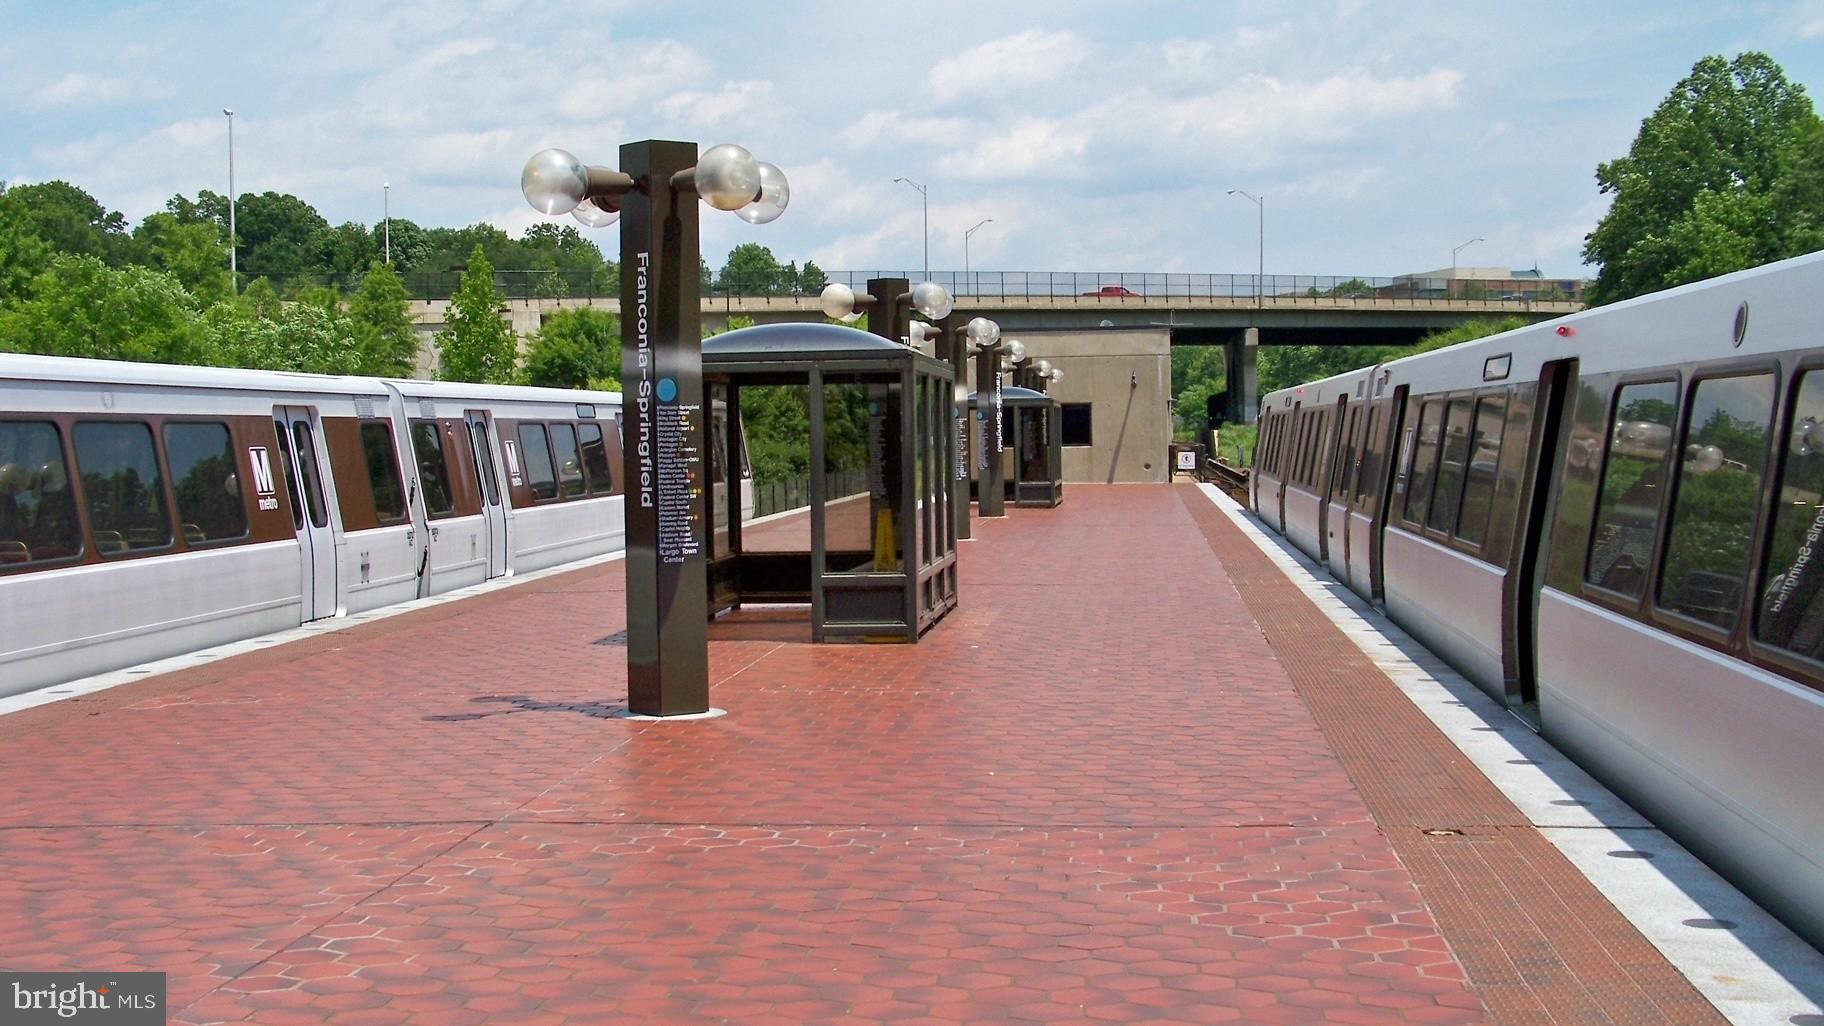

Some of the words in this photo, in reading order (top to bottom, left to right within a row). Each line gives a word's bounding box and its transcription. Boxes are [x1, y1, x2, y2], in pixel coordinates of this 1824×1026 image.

[637, 252, 653, 507] Franconia-Springfield
[258, 496, 278, 511] metro
[681, 547, 698, 555] Town
